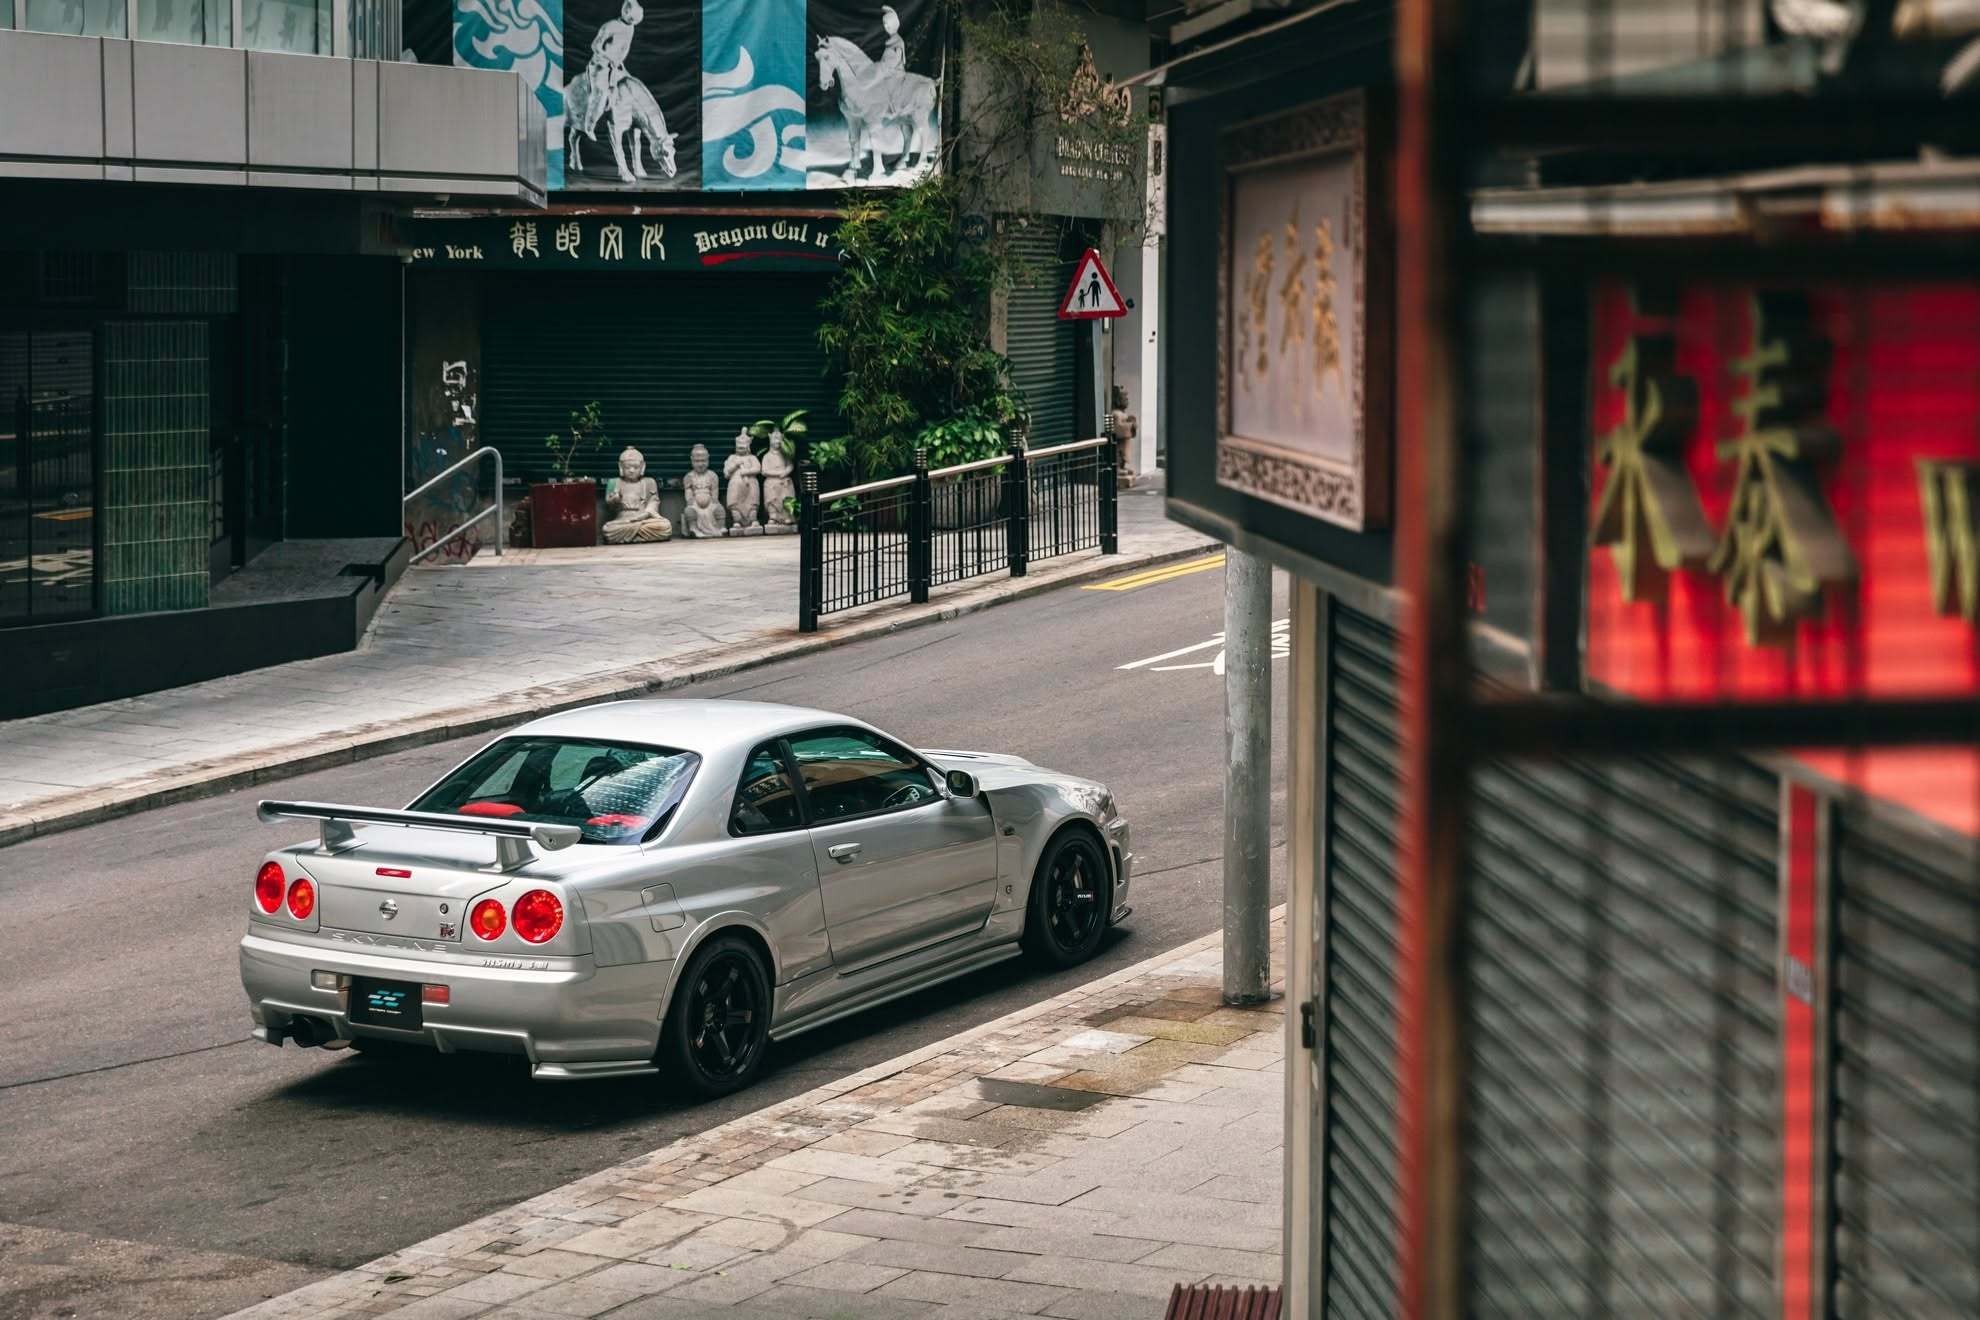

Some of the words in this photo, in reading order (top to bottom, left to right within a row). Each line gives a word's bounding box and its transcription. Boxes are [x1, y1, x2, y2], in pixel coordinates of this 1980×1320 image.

[694, 224, 768, 253] Dragon
[411, 246, 436, 259] ew
[445, 244, 484, 260] York
